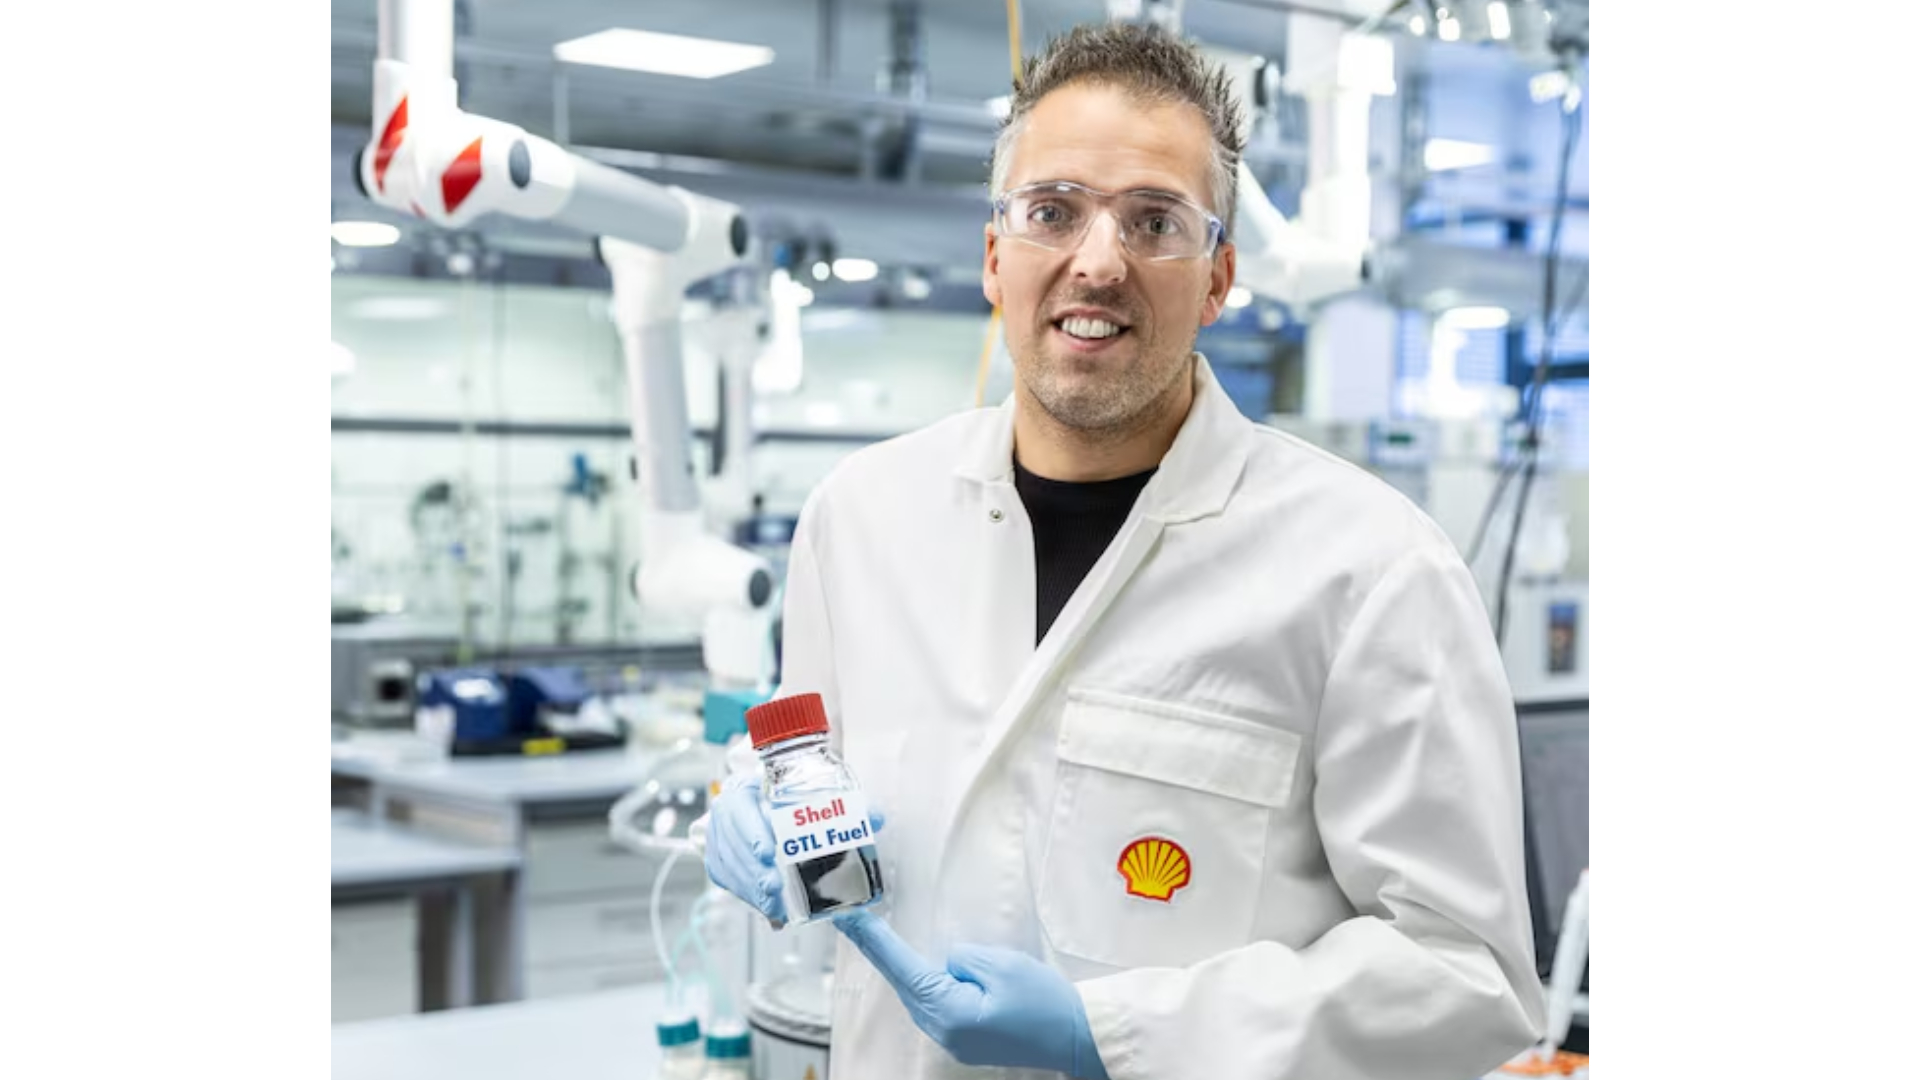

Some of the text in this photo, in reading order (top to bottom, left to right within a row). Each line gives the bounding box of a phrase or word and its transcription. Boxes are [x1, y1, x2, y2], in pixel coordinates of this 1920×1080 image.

[793, 798, 845, 826] Shell
[783, 820, 868, 856] GTL Fuel
